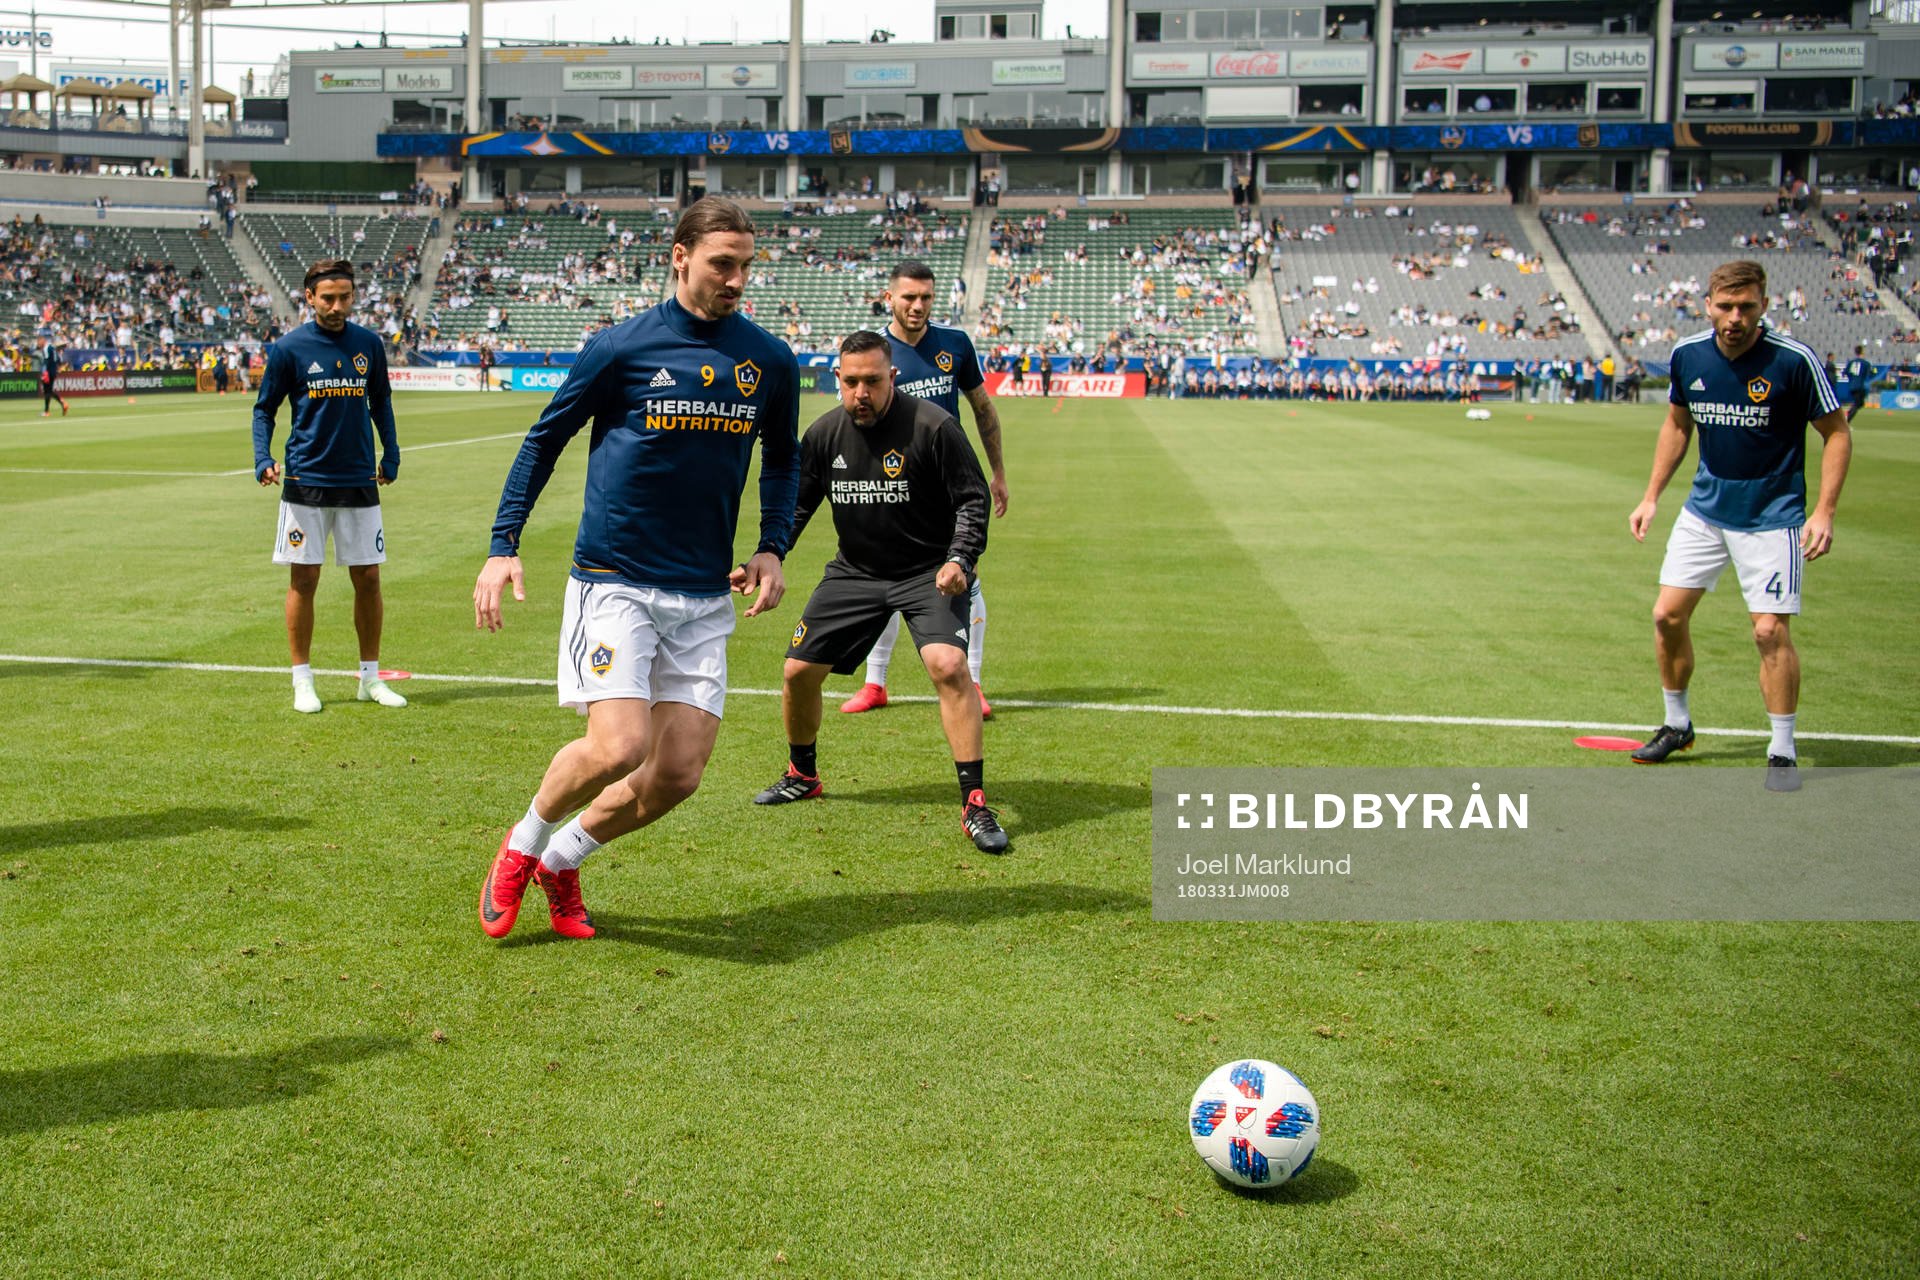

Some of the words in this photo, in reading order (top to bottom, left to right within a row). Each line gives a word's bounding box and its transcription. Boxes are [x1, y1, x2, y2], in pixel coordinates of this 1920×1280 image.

[1795, 47, 1817, 56] SAN
[1819, 46, 1863, 56] MANUEL
[1573, 51, 1646, 66] StubHub
[1148, 61, 1189, 72] Frontier
[397, 74, 440, 88] Modelo
[572, 71, 622, 80] HORNITOS
[657, 72, 702, 81] TOYOTA
[1507, 126, 1533, 144] VS
[1706, 124, 1767, 135] FOOTBALL
[1768, 124, 1801, 135] CLUB
[766, 133, 790, 150] VS
[126, 376, 163, 388] HERBALIFE
[701, 365, 715, 387] 9
[741, 371, 755, 384] LA
[65, 378, 97, 391] MANUEL
[649, 379, 677, 388] adidas
[1752, 384, 1765, 393] LA
[646, 399, 757, 419] HERBALIFE
[1688, 401, 1770, 417] HERBALIFE
[645, 415, 753, 434] NUTRITION
[1691, 412, 1769, 427] NUTRITION
[886, 459, 899, 468] LA
[831, 480, 909, 492] HERBALIFE
[832, 491, 910, 504] NUTRITION
[376, 528, 384, 552] 6
[1765, 572, 1783, 600] 4
[594, 654, 609, 666] LA
